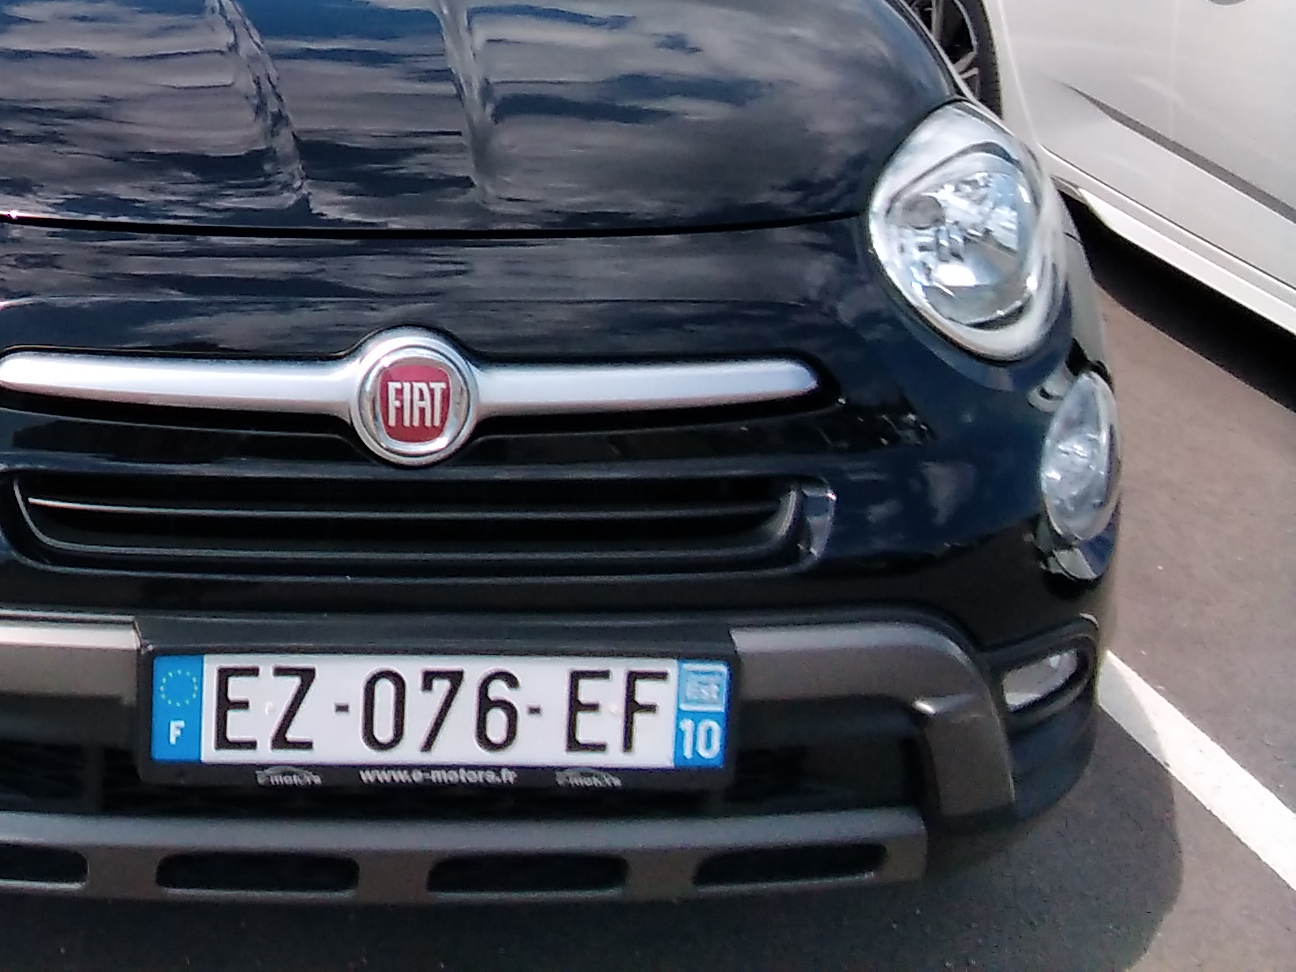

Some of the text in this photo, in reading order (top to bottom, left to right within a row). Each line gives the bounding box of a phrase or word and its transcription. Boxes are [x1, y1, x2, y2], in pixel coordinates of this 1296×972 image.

[387, 381, 447, 427] FIAT
[169, 720, 185, 745] F
[679, 719, 724, 759] 10
[359, 768, 518, 785] www.e-motors.fr
